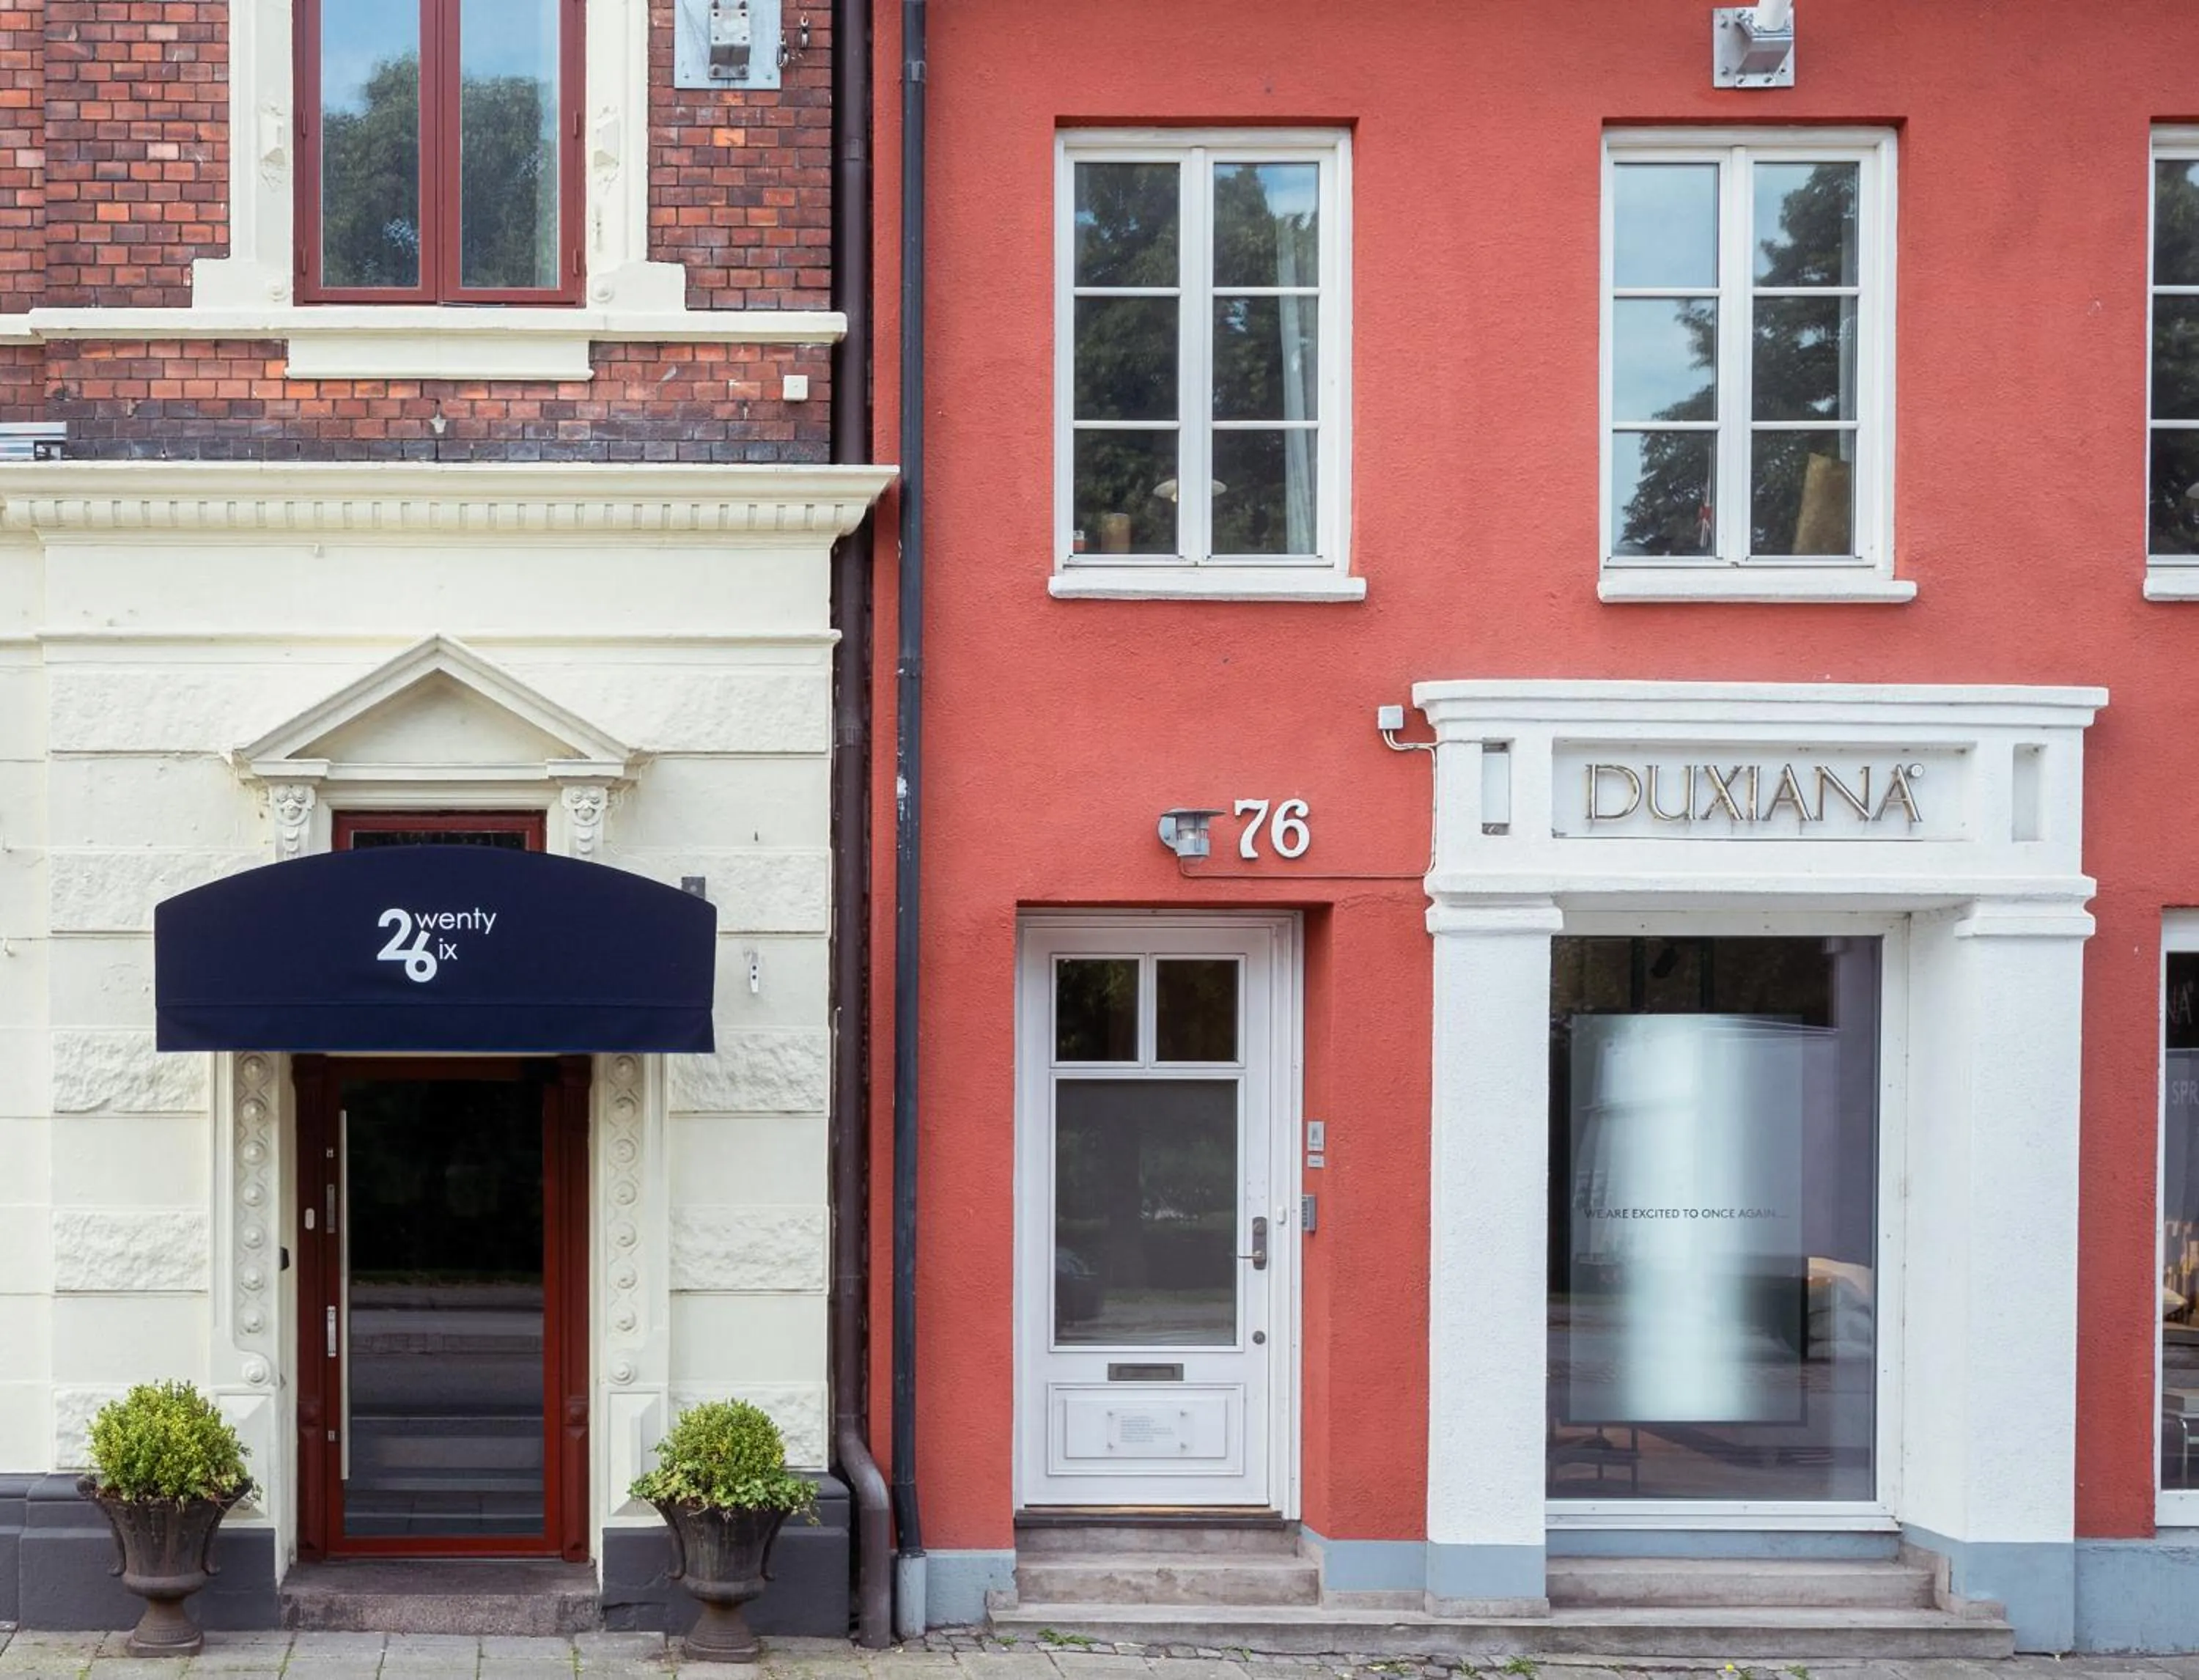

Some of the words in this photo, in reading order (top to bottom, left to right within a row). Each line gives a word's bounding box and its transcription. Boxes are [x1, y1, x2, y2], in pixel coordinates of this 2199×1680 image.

[1234, 798, 1310, 858] 76
[1584, 1209, 1604, 1218] WE
[1607, 1209, 1629, 1218] ARE
[1632, 1209, 1679, 1218] EXCITED
[1683, 1209, 1698, 1218] TO
[1701, 1209, 1735, 1218] ONCE
